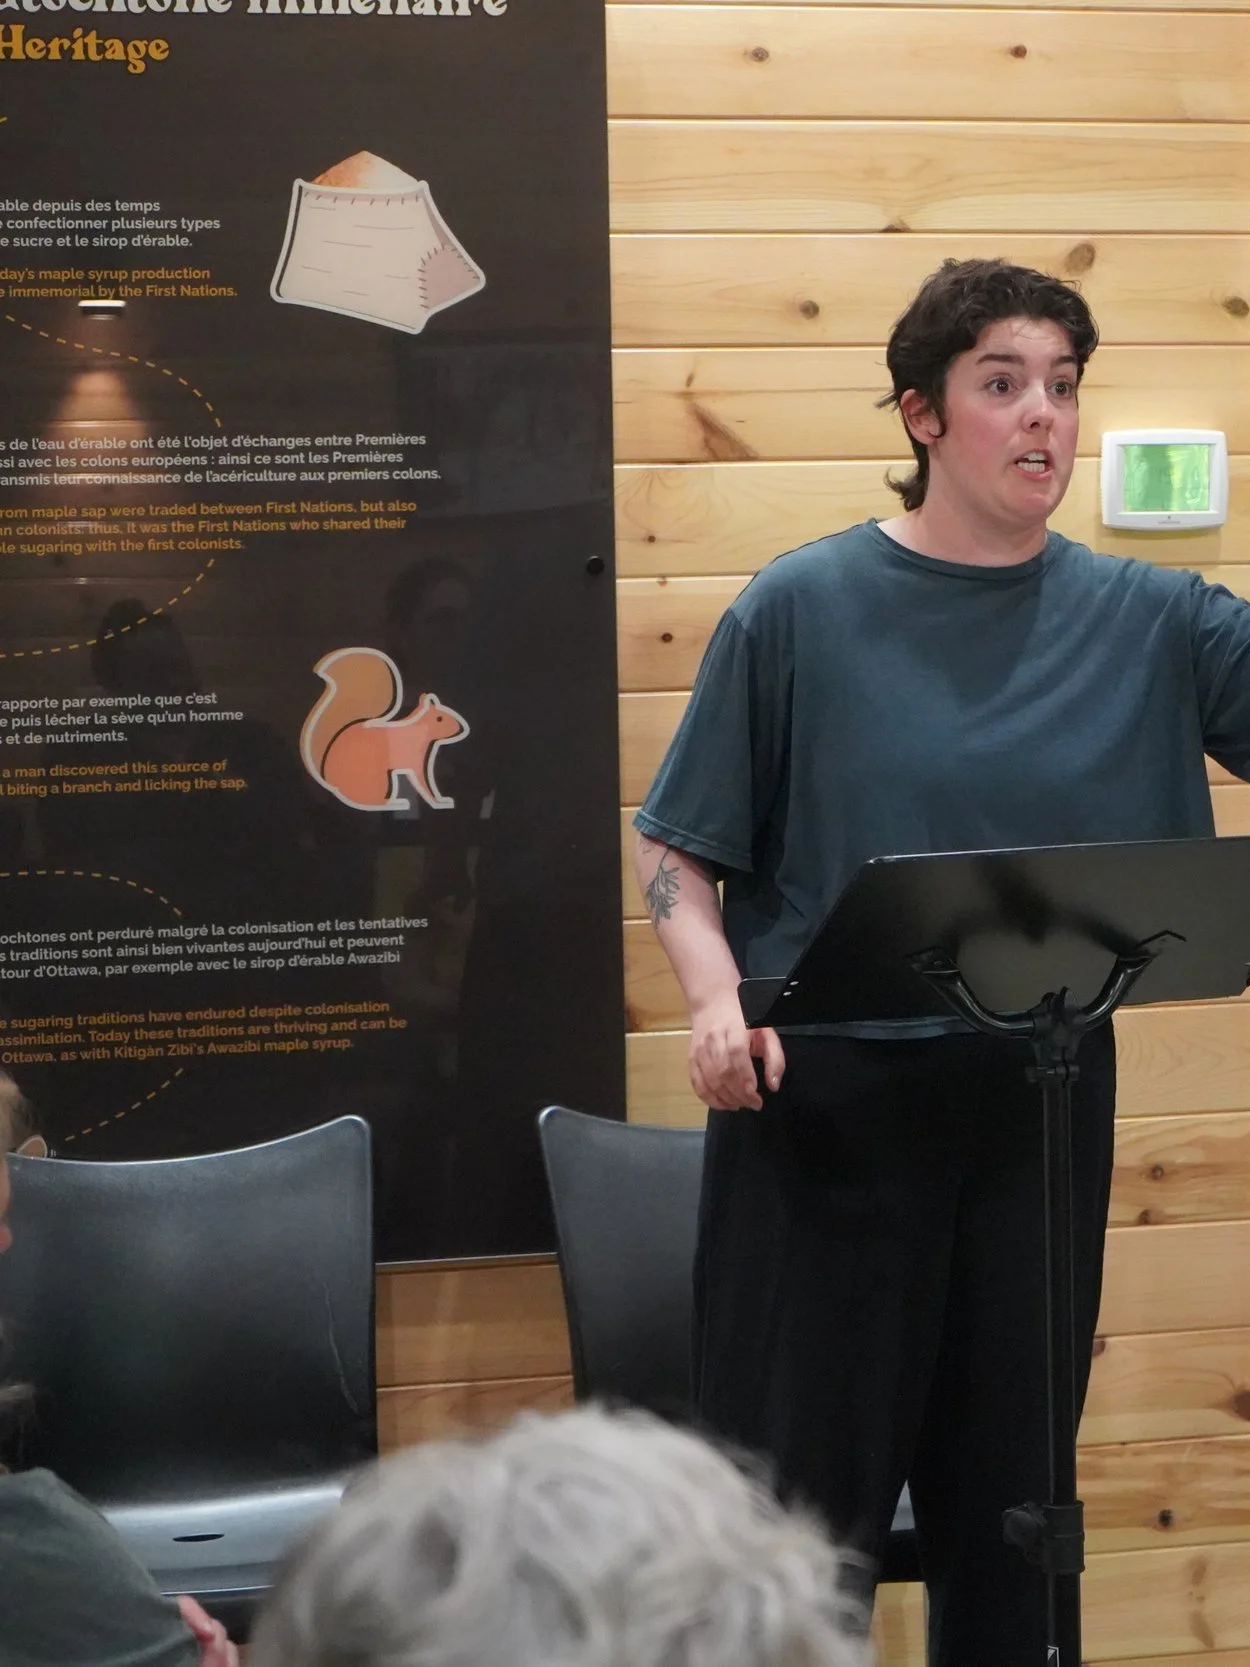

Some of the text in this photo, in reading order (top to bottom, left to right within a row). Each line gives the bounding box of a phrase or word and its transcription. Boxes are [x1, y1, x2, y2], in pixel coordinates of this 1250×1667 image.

[0, 24, 169, 73] Heritage
[32, 199, 82, 214] depuis
[85, 199, 111, 211] des
[115, 200, 160, 214] temps
[7, 217, 108, 229] confectionner
[111, 217, 177, 232] plusieurs
[181, 217, 221, 232] types
[13, 236, 53, 247] sucre
[56, 235, 71, 247] et
[75, 235, 89, 247] le
[92, 234, 128, 249] sirop
[131, 234, 193, 247] d'érable.
[39, 268, 85, 282] maple
[88, 270, 128, 282] syrup
[132, 267, 210, 282] production
[9, 285, 95, 298] immemorial
[100, 285, 115, 300] by
[119, 285, 142, 297] the
[146, 285, 176, 297] First
[180, 285, 237, 297] Nations.
[9, 438, 28, 450] de
[32, 438, 65, 450] l'eau
[69, 437, 126, 450] d'érable
[132, 437, 154, 449] ont
[157, 436, 181, 448] été
[184, 435, 228, 450] l'objet
[232, 435, 311, 449] d'échanges
[315, 435, 351, 446] entre
[356, 433, 426, 445] Premières
[18, 458, 52, 468] avec
[56, 456, 77, 467] les
[80, 455, 128, 467] colons
[132, 454, 207, 468] européens
[218, 453, 250, 465] ainsi
[254, 455, 269, 465] ce
[274, 453, 304, 464] sont
[308, 452, 329, 463] les
[333, 450, 403, 463] Premières
[184, 472, 202, 483] de
[206, 470, 297, 482] l'acériculture
[300, 471, 325, 481] aux
[328, 468, 389, 483] premiers
[393, 468, 441, 480] colons.
[32, 506, 77, 520] maple
[82, 507, 106, 520] sap
[110, 507, 145, 517] were
[150, 503, 196, 516] traded
[201, 502, 262, 515] between
[266, 502, 296, 513] First
[361, 500, 384, 512] but
[388, 499, 417, 511] also
[140, 522, 167, 533] was
[171, 520, 194, 532] the
[198, 520, 228, 532] First
[233, 519, 286, 531] Nations
[290, 519, 319, 530] who
[323, 517, 370, 530] shared
[374, 517, 406, 529] their
[20, 540, 82, 556] sugaring
[86, 539, 117, 551] with
[120, 538, 145, 550] the
[148, 538, 173, 550] first
[0, 692, 217, 712] apporte par exemple que c'est
[12, 714, 42, 730] puis
[45, 713, 91, 725] lécher
[94, 712, 108, 724] la
[111, 712, 144, 724] sève
[147, 711, 186, 726] qu'un
[189, 709, 244, 722] homme
[6, 733, 20, 745] et
[24, 732, 43, 744] de
[46, 729, 128, 743] nutriments.
[2, 758, 228, 778] a man discovered this source of
[7, 783, 47, 798] biting
[50, 784, 59, 794] a
[63, 780, 112, 794] branch
[115, 779, 141, 792] and
[145, 778, 191, 793] licking
[194, 776, 217, 789] the
[70, 929, 94, 942] ont
[97, 926, 154, 943] perduré
[158, 924, 208, 940] malgré
[212, 923, 225, 936] la
[228, 921, 313, 935] colonisation
[317, 919, 331, 932] et
[335, 918, 355, 931] les
[359, 917, 428, 930] tentatives
[10, 948, 78, 962] traditions
[82, 946, 113, 959] sont
[116, 944, 148, 957] ainsi
[152, 943, 183, 956] bien
[186, 940, 245, 954] vivantes
[248, 937, 326, 953] aujourd'hui
[329, 936, 344, 948] et
[347, 934, 404, 950] peuvent
[33, 965, 102, 979] d'Ottawa,
[105, 964, 129, 978] par
[131, 959, 194, 976] exemple
[197, 961, 230, 972] avec
[233, 958, 247, 970] le
[250, 956, 285, 971] sirop
[288, 954, 345, 968] d'érable
[347, 951, 400, 965] Awazibi
[11, 1015, 73, 1031] sugaring
[77, 1012, 145, 1026] traditions
[148, 1011, 182, 1023] have
[185, 1007, 245, 1022] endured
[249, 1004, 302, 1019] despite
[305, 1000, 390, 1015] colonisation
[88, 1029, 131, 1044] Today
[134, 1027, 173, 1040] these
[177, 1023, 244, 1038] traditions
[248, 1025, 271, 1035] are
[274, 1020, 328, 1034] thriving
[330, 1018, 357, 1031] and
[360, 1019, 386, 1030] can
[389, 1016, 407, 1029] be
[60, 1051, 76, 1061] as
[80, 1047, 110, 1060] with
[264, 1038, 309, 1054] maple
